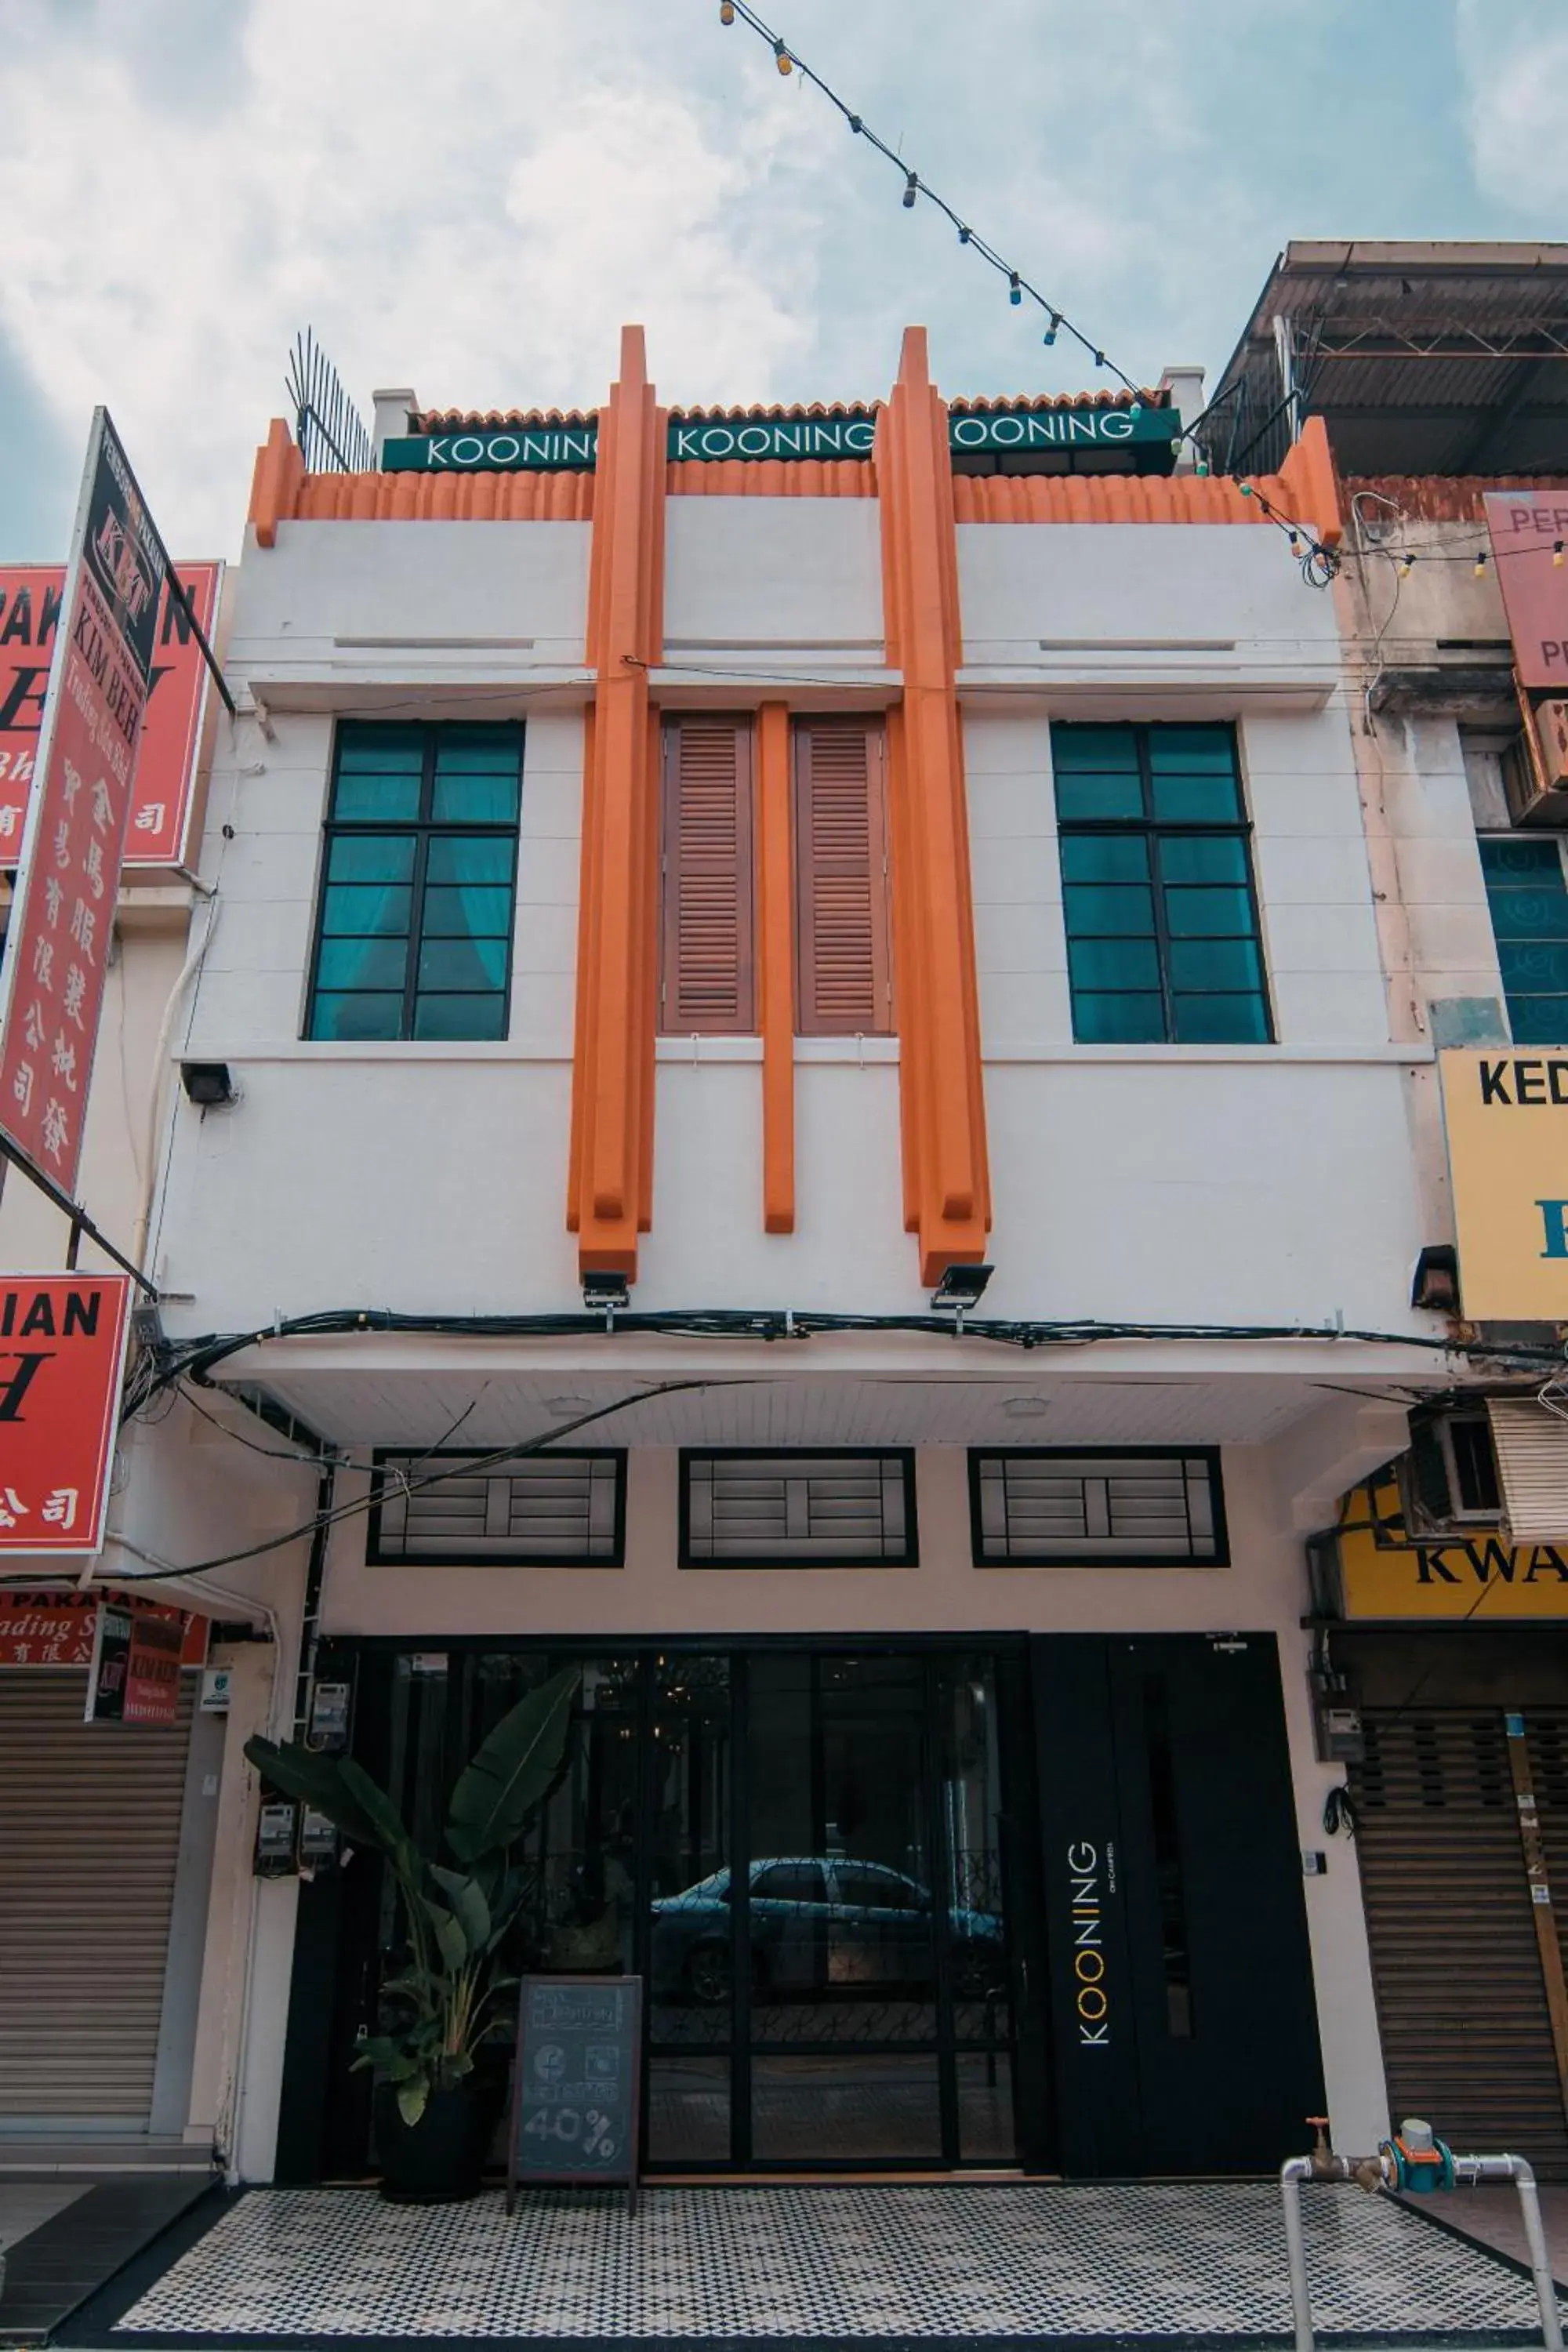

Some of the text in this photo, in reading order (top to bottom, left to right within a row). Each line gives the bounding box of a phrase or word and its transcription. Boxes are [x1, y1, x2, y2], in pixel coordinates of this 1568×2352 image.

[428, 434, 598, 464] KOONIN
[677, 423, 876, 456] KOONING
[947, 412, 1134, 445] OONING
[74, 601, 110, 687] KIM
[106, 664, 139, 747] BEH
[1068, 1842, 1109, 2045] KOONING
[524, 2107, 615, 2158] 40%
